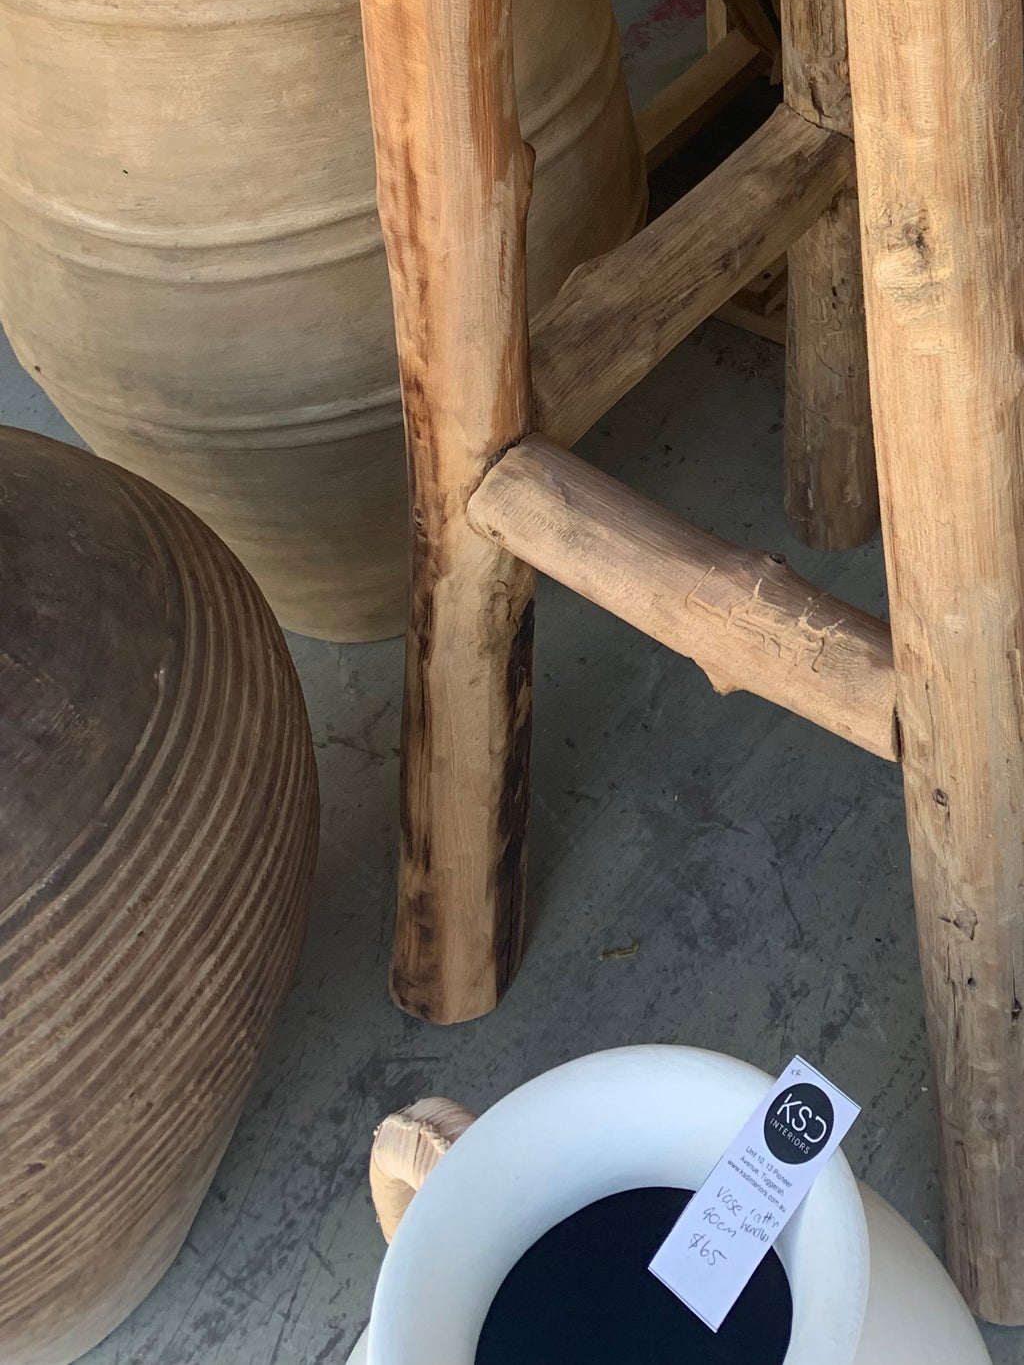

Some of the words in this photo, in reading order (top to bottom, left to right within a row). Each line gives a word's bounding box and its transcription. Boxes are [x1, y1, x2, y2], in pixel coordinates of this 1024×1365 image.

[769, 1117, 811, 1155] INTERIORS
[776, 1093, 827, 1143] KSD
[727, 1160, 787, 1213] www.ksdinteriors.com.au
[745, 1145, 757, 1158] Unit
[766, 1163, 774, 1172] 13
[772, 1168, 792, 1188] Pioneer
[688, 1233, 728, 1266] $65
